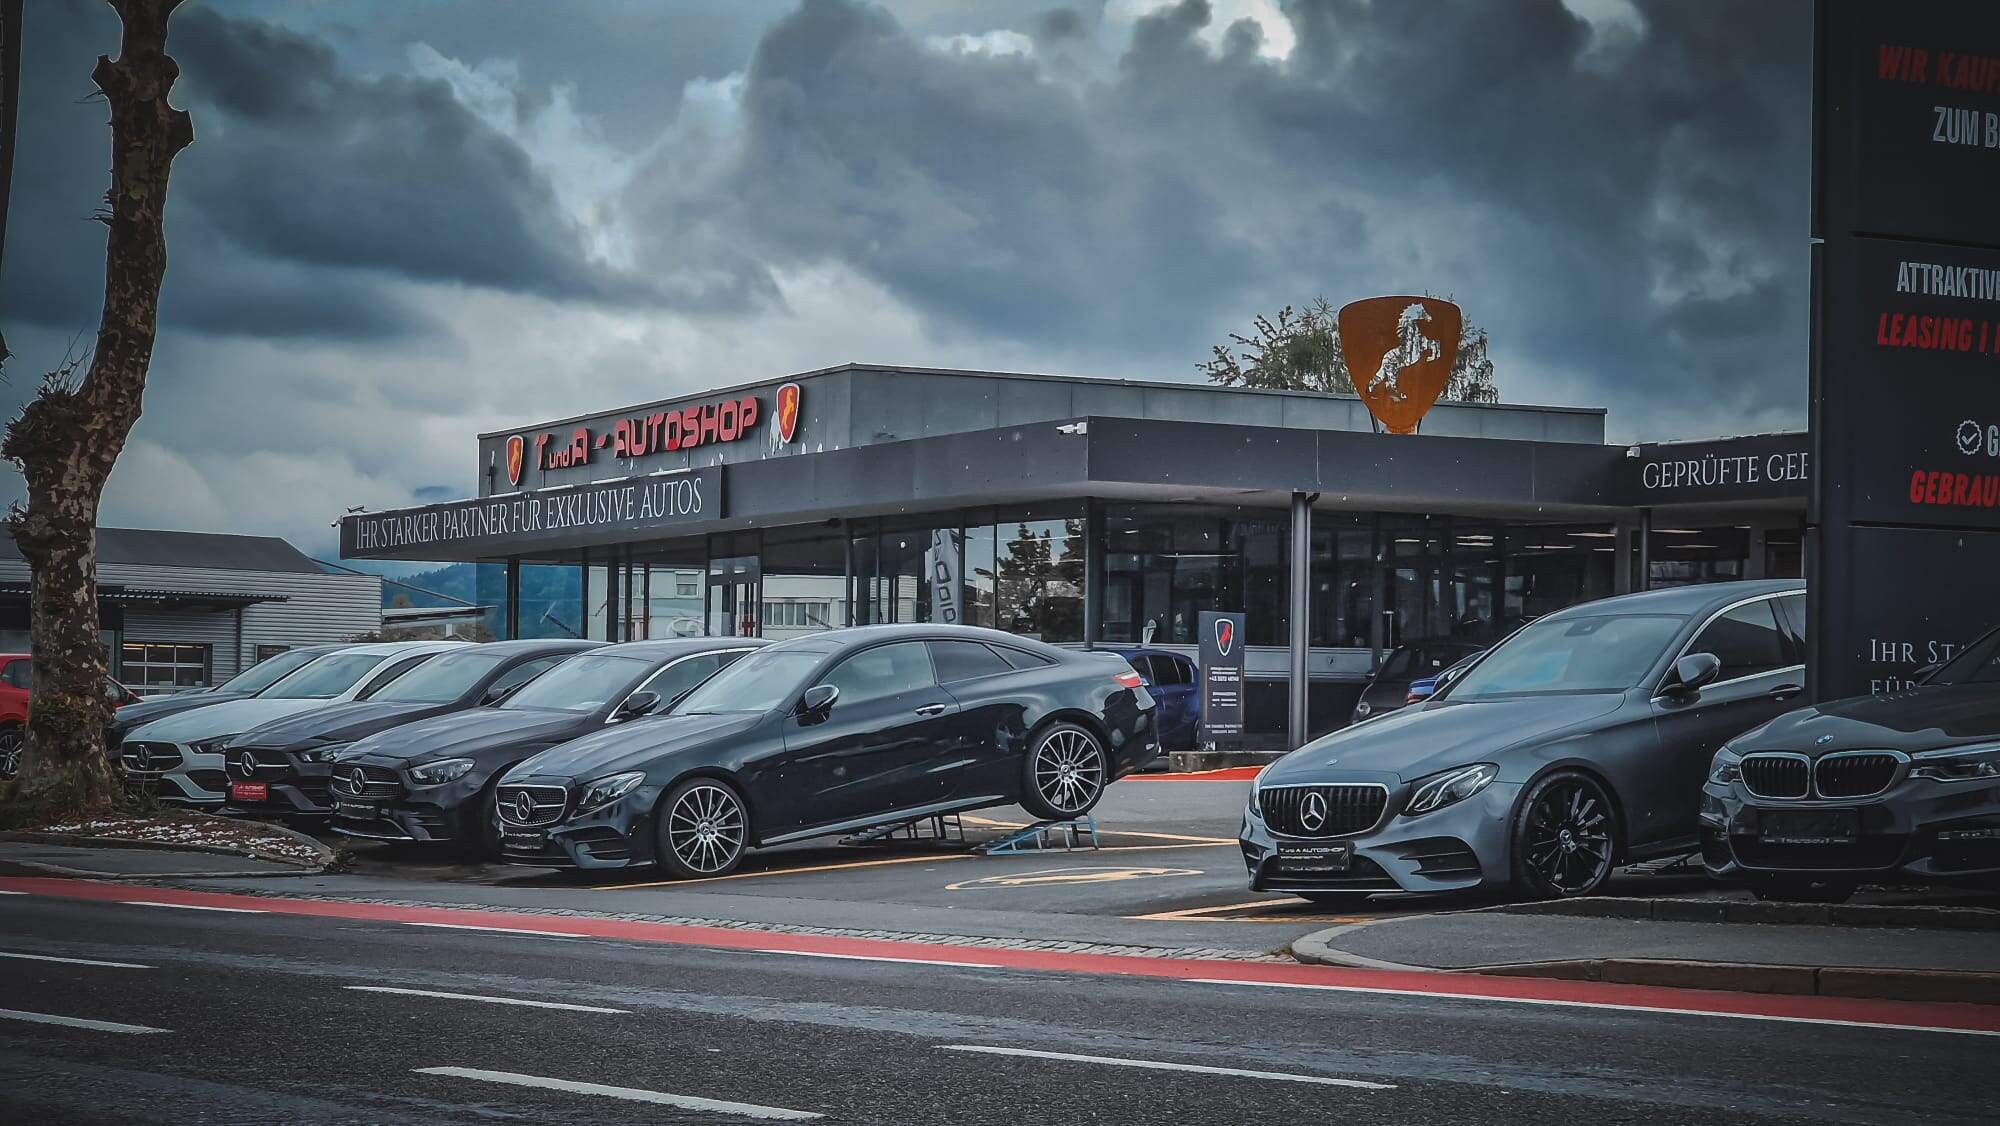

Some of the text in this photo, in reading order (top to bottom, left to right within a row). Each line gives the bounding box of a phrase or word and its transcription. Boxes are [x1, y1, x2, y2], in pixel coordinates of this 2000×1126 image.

[1879, 45, 1928, 83] WIR
[1933, 106, 2000, 148] ZUM B
[1877, 312, 1973, 352] LEASING
[535, 432, 551, 470] T
[549, 444, 571, 468] und
[572, 427, 589, 466] A
[614, 397, 758, 458] AUTOSHOP
[1987, 424, 2000, 457] G
[1643, 453, 1760, 489] GEPRÜFTE
[1910, 469, 2000, 507] GEBRAU
[382, 512, 438, 548] STARKER
[443, 503, 509, 540] PARTNER
[512, 493, 541, 532] FÜR
[546, 487, 635, 529] EXKLUSIVE
[639, 477, 702, 519] AUTOS
